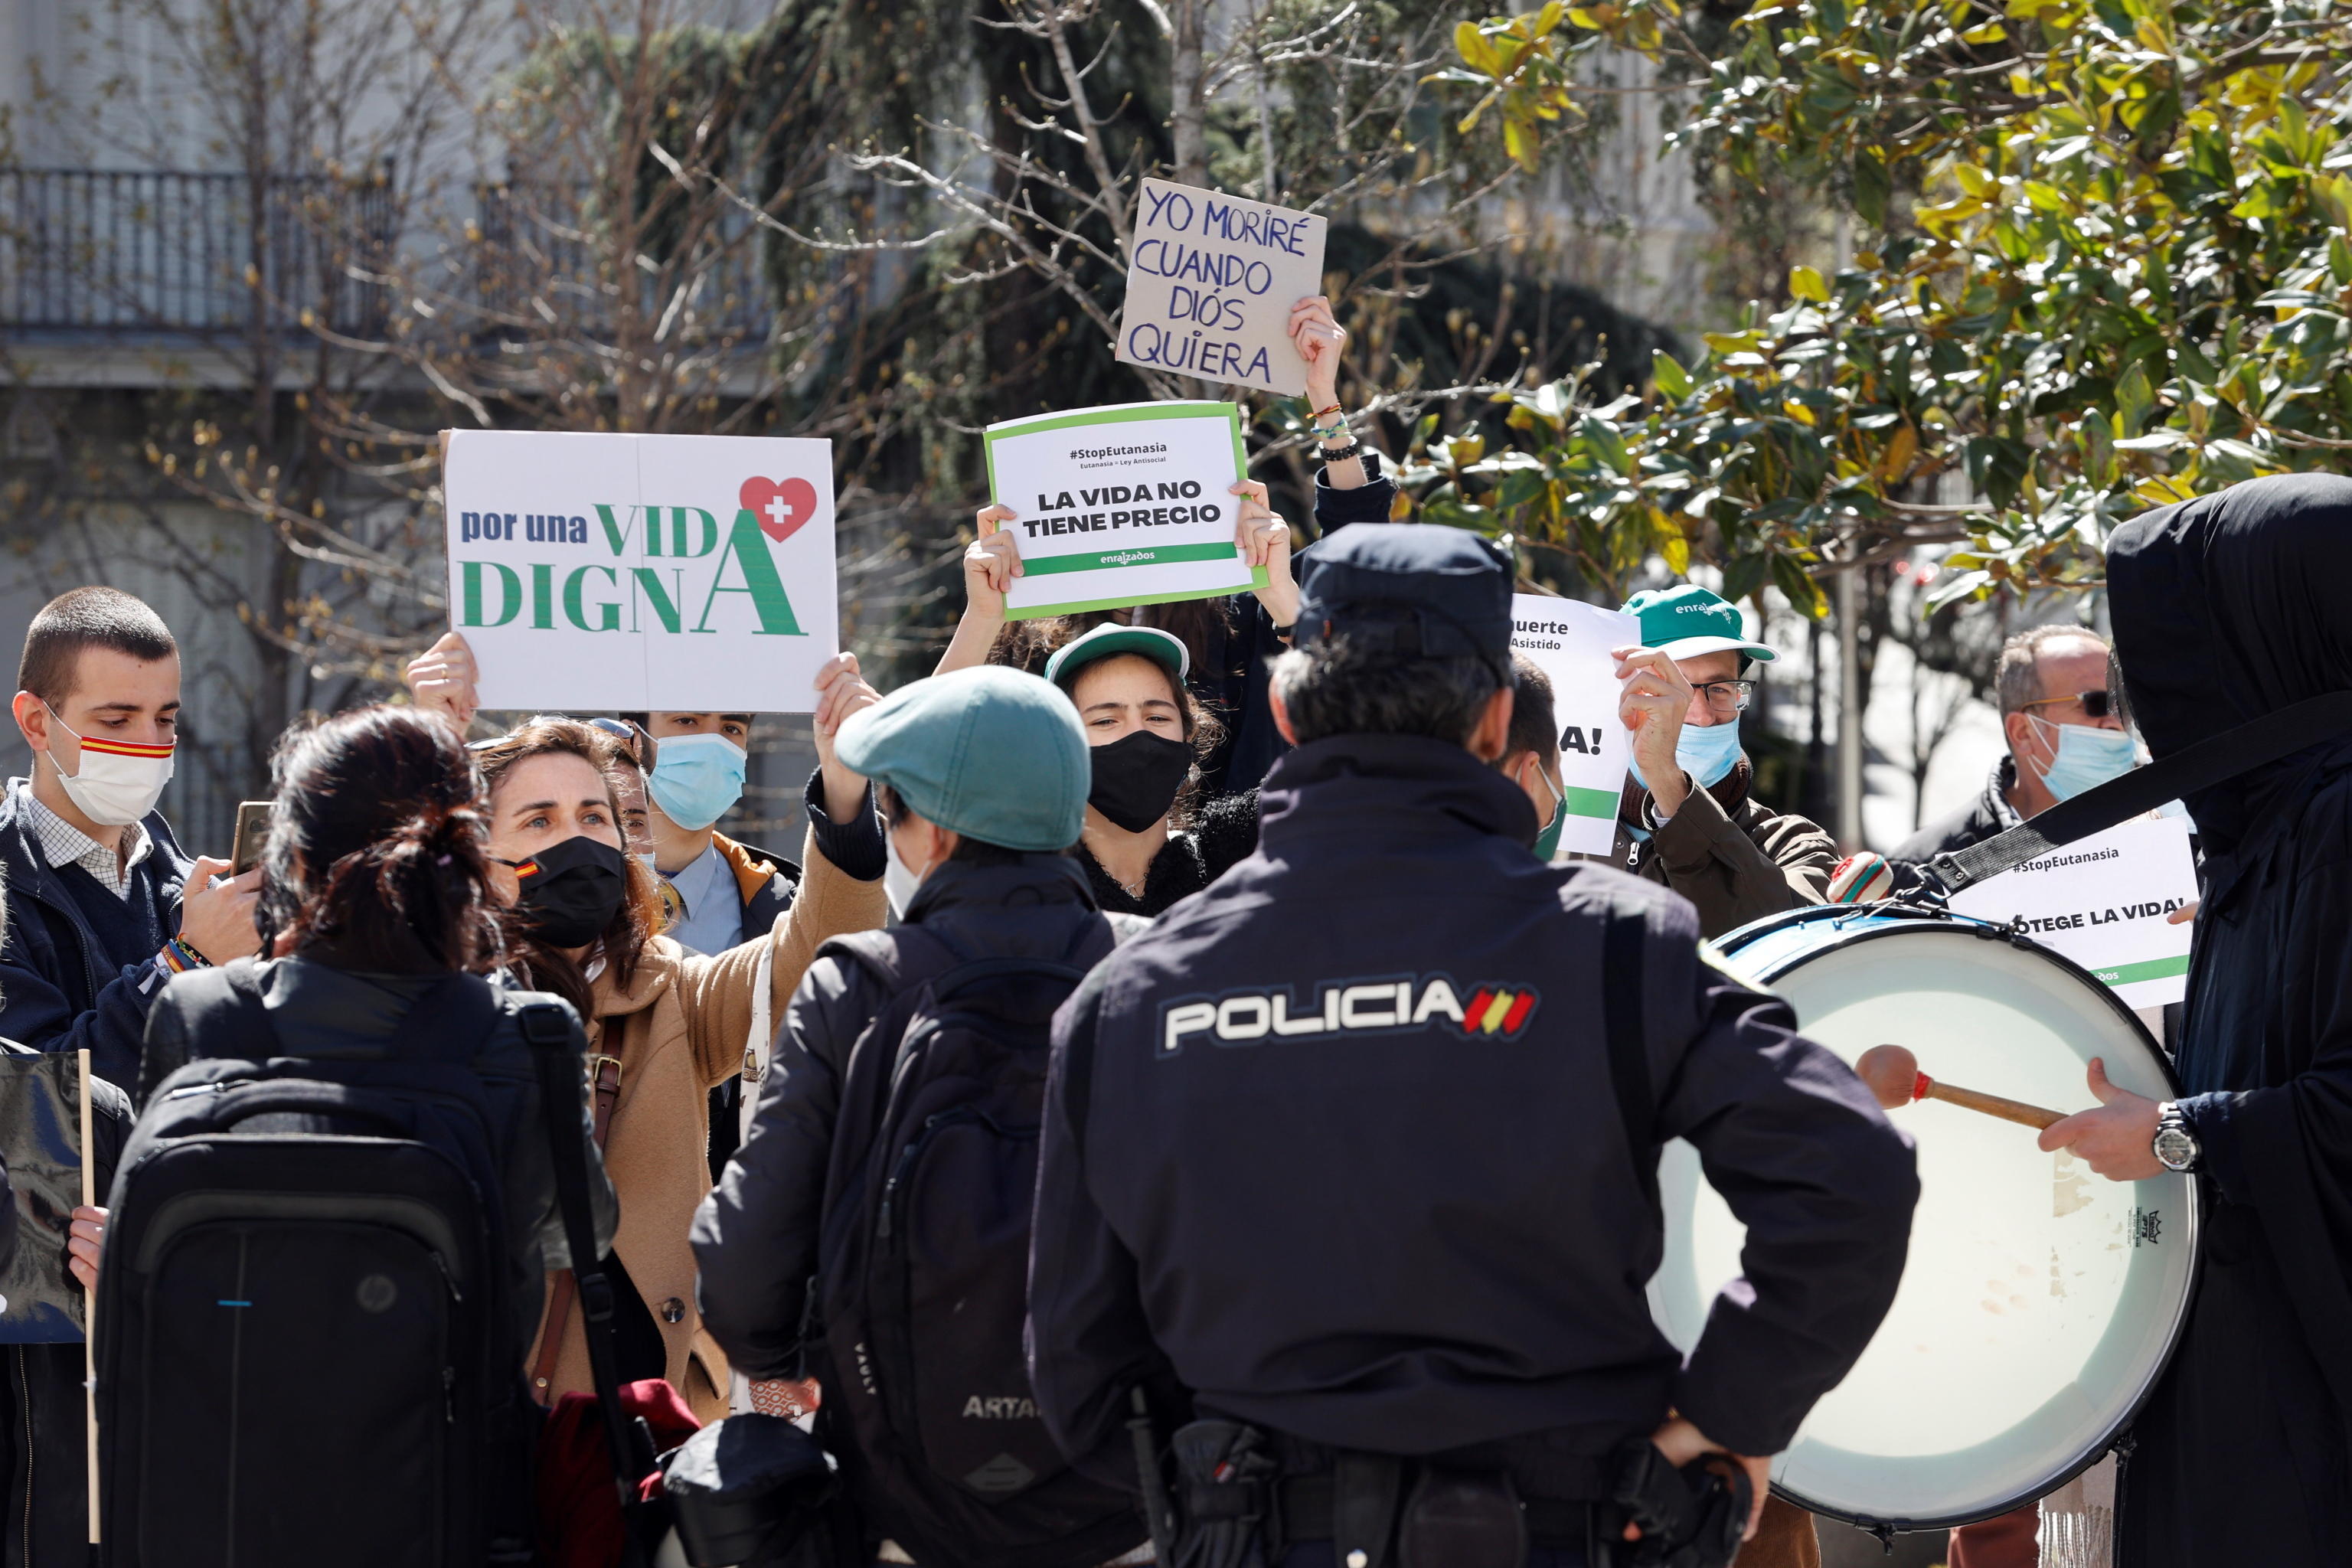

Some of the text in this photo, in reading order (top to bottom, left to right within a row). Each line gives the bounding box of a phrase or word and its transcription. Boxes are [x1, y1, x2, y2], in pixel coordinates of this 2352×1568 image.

[1145, 186, 1194, 231] YO
[1135, 239, 1272, 295] CUANDO
[1069, 443, 1167, 460] #StopEutanasia
[1037, 480, 1201, 511] LA VIDA NO
[460, 511, 517, 542] por
[525, 514, 587, 543] una
[1023, 504, 1221, 537] TIENE PRECIO
[1100, 551, 1155, 565] enraizados
[1511, 620, 1568, 635] uerte
[1511, 638, 1561, 650] Asistido
[2013, 847, 2119, 873] #StopEutanasia
[2016, 913, 2084, 935] OTEGE
[2089, 908, 2120, 926] LA
[1165, 979, 1466, 1050] POLICIA
